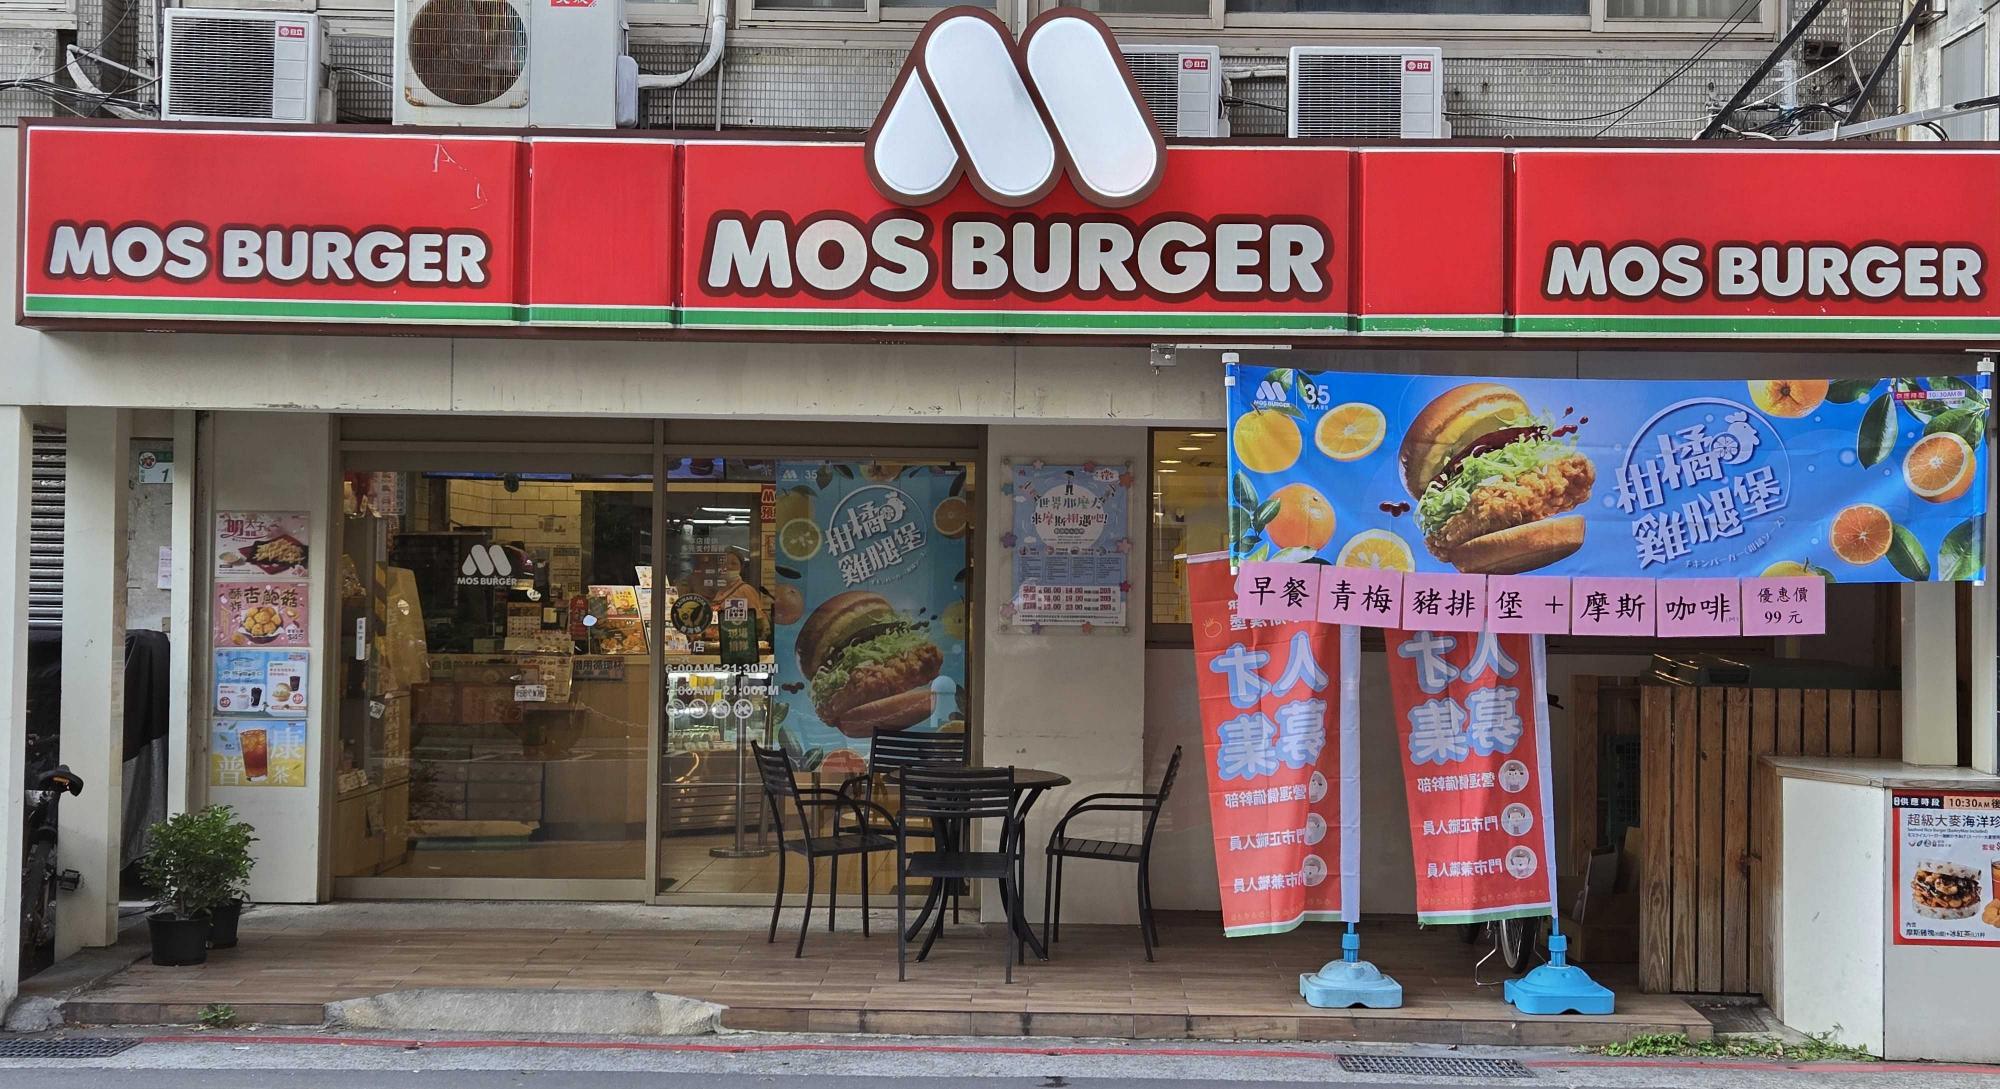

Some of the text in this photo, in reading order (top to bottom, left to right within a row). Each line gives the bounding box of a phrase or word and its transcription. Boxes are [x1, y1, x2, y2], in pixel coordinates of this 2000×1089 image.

[50, 226, 486, 284] MOS BURGER
[708, 218, 1324, 294] MOS BURGER
[1547, 245, 1983, 298] MOS BURGER
[1303, 383, 1331, 405] 35
[1614, 423, 1723, 514] 柑橘
[825, 501, 888, 556] 柑橘
[1631, 466, 1782, 569] 雞腿堡
[457, 577, 518, 586] MOS BURGER
[839, 521, 922, 588] 雞腿堡
[1248, 576, 1310, 609] 早餐
[1330, 579, 1393, 615] 青梅
[1411, 587, 1476, 618] 豬排
[1580, 591, 1646, 624] 摩斯
[1666, 594, 1732, 624] 咖啡
[1758, 587, 1809, 603] 優惠價
[1764, 611, 1803, 624] 99 元
